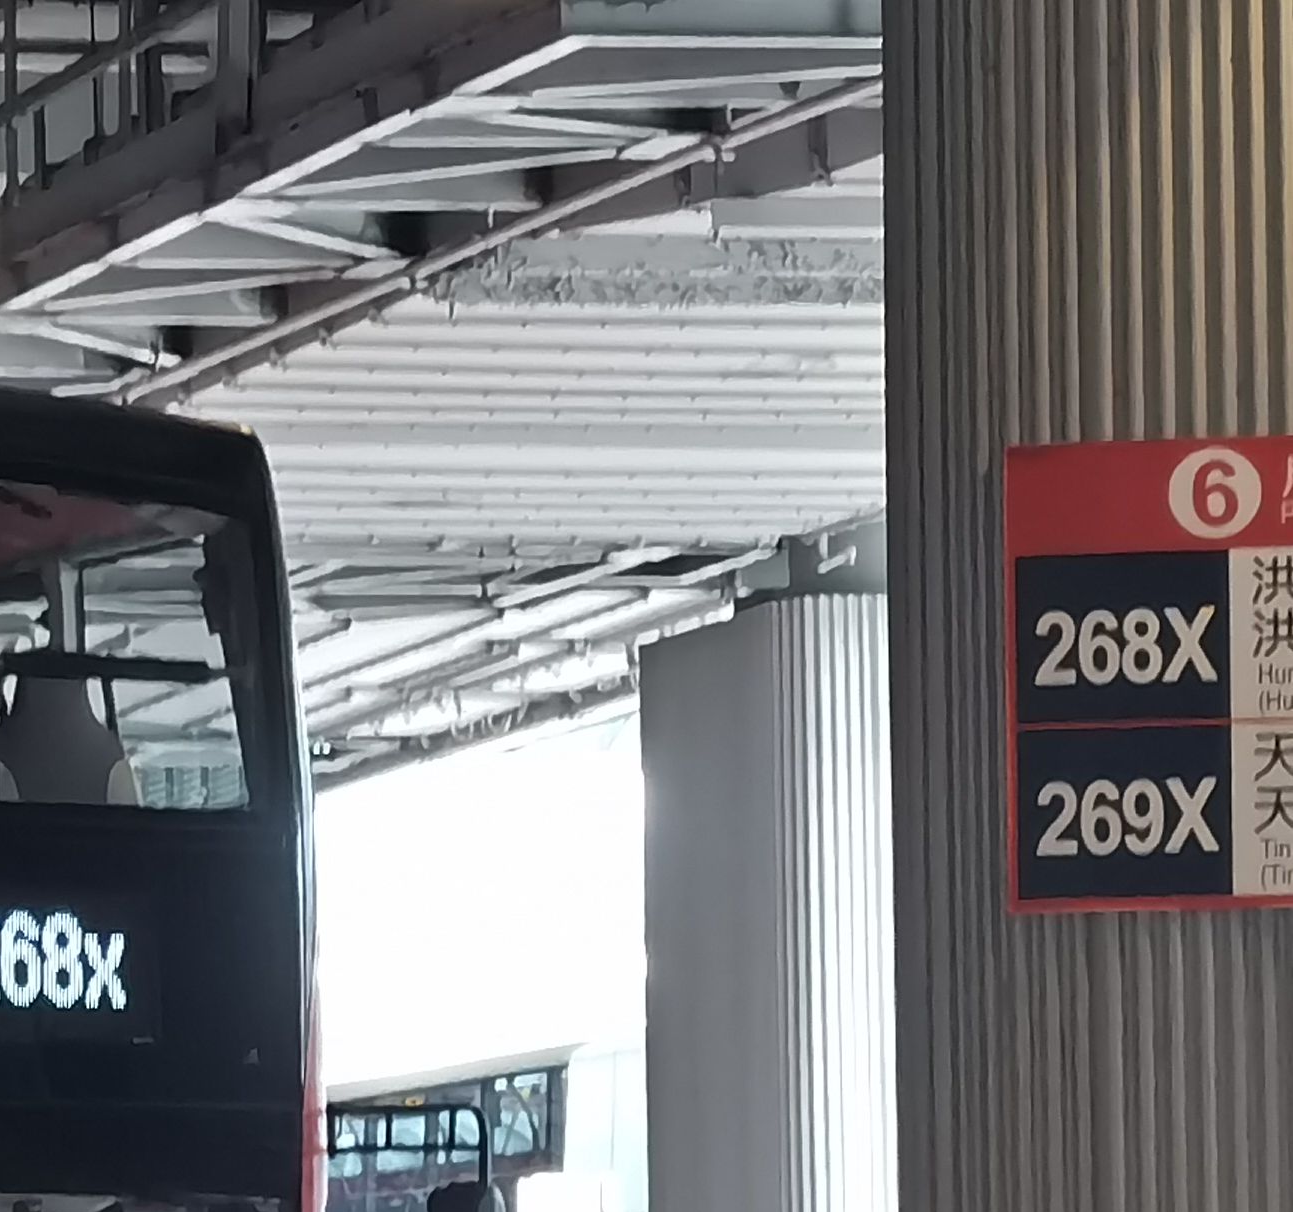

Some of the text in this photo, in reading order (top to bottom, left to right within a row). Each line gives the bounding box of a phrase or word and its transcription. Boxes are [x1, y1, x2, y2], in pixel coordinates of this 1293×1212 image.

[1191, 458, 1240, 529] 6
[1034, 605, 1219, 687] 268X
[1035, 776, 1220, 858] 269X
[1260, 838, 1292, 859] Tin
